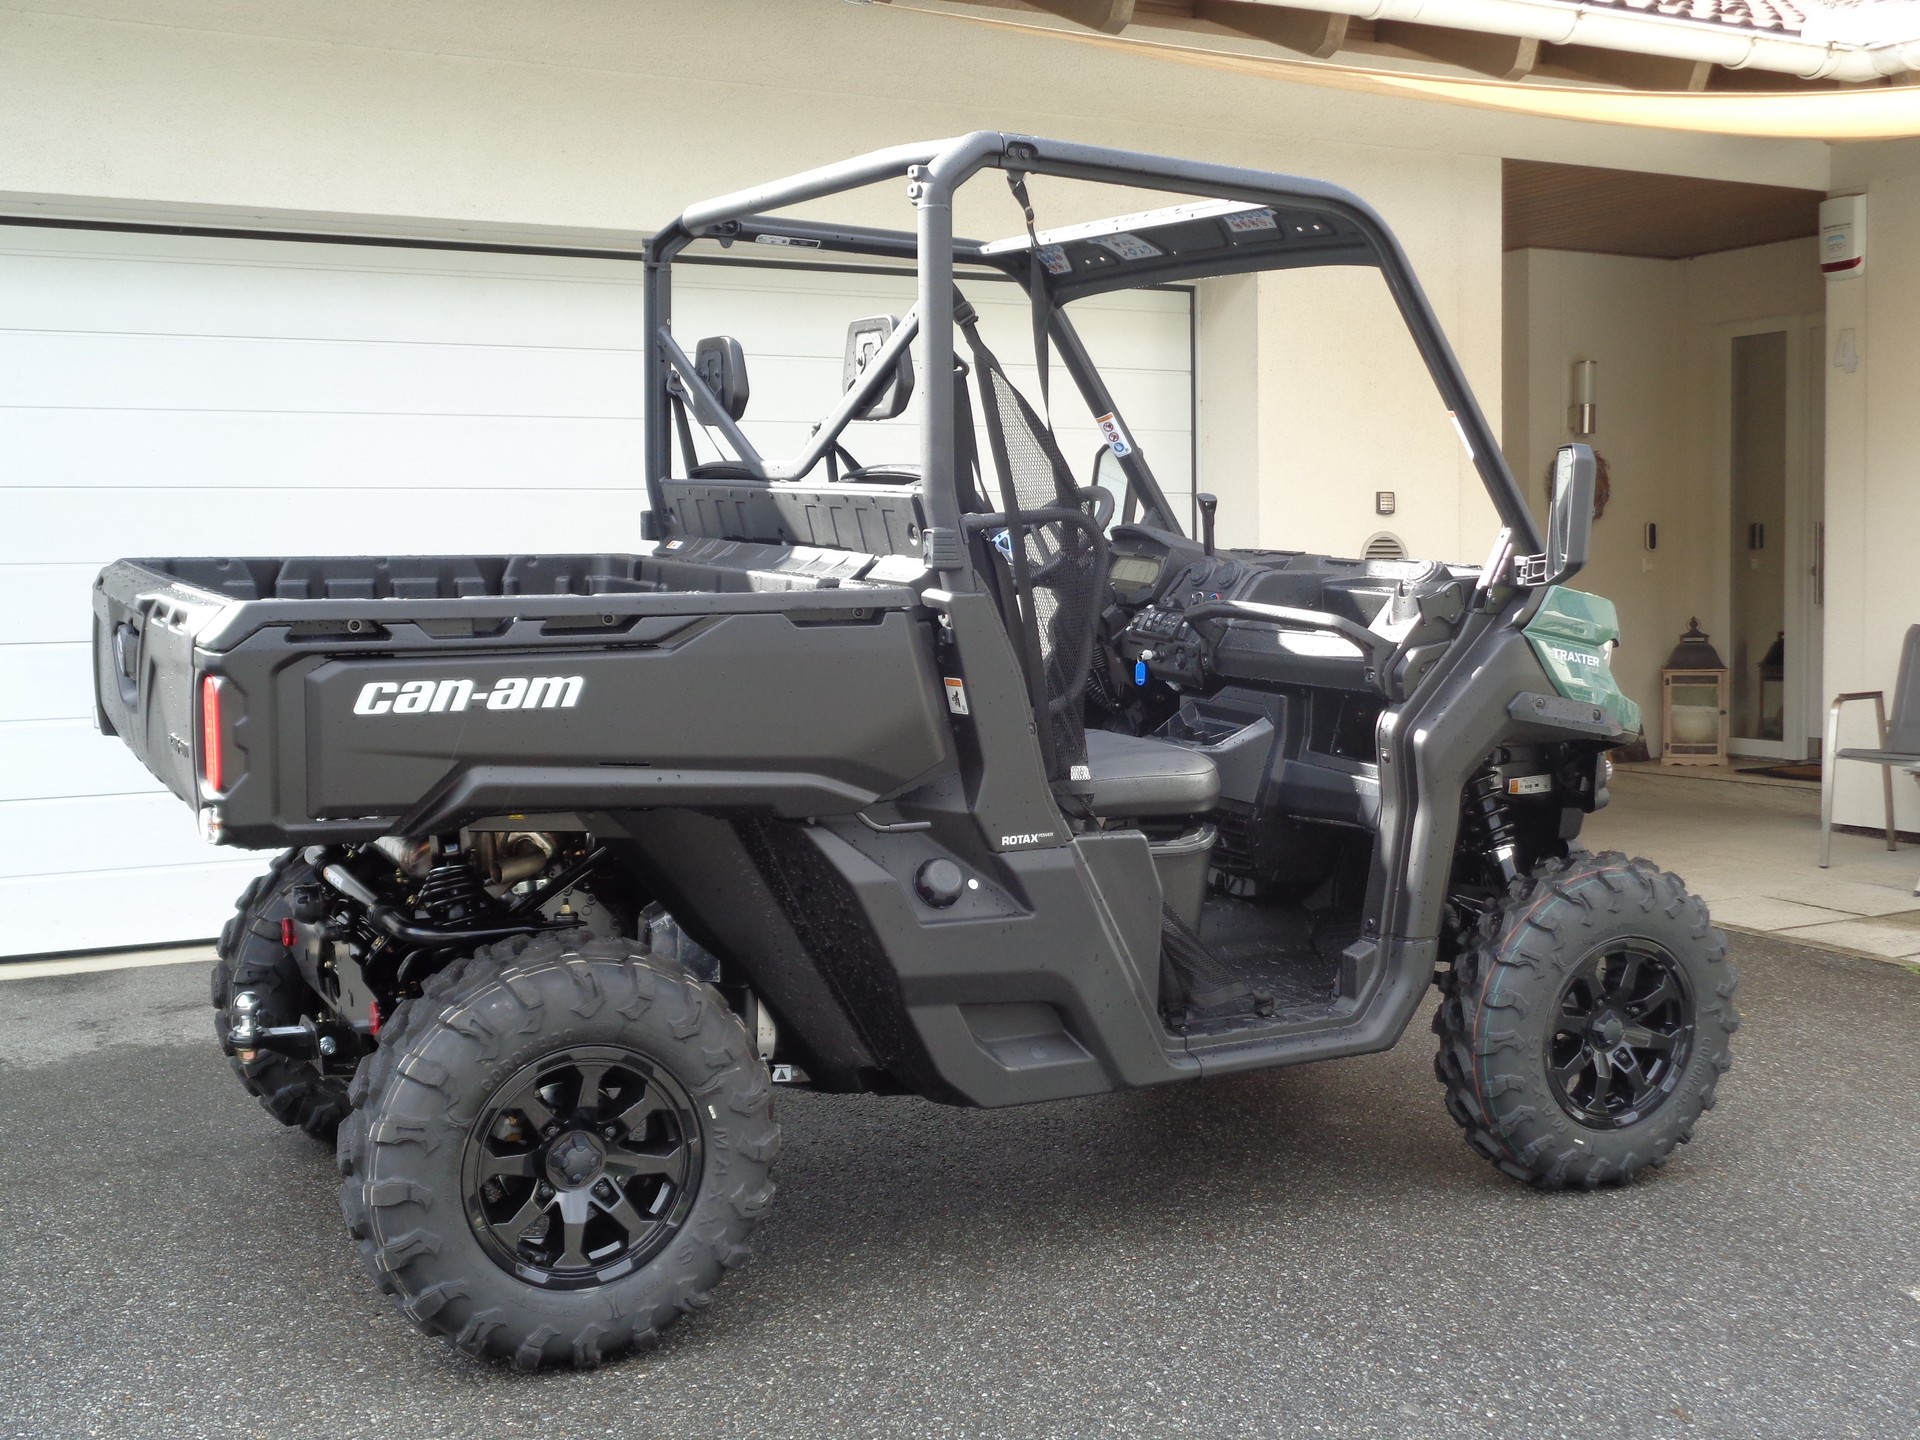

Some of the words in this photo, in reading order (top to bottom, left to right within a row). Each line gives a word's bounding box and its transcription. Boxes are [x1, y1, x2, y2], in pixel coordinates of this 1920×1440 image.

[1833, 328, 1858, 374] 4
[1552, 648, 1600, 667] TRAXTER
[353, 676, 584, 715] can-am
[1001, 833, 1039, 846] ROTAX
